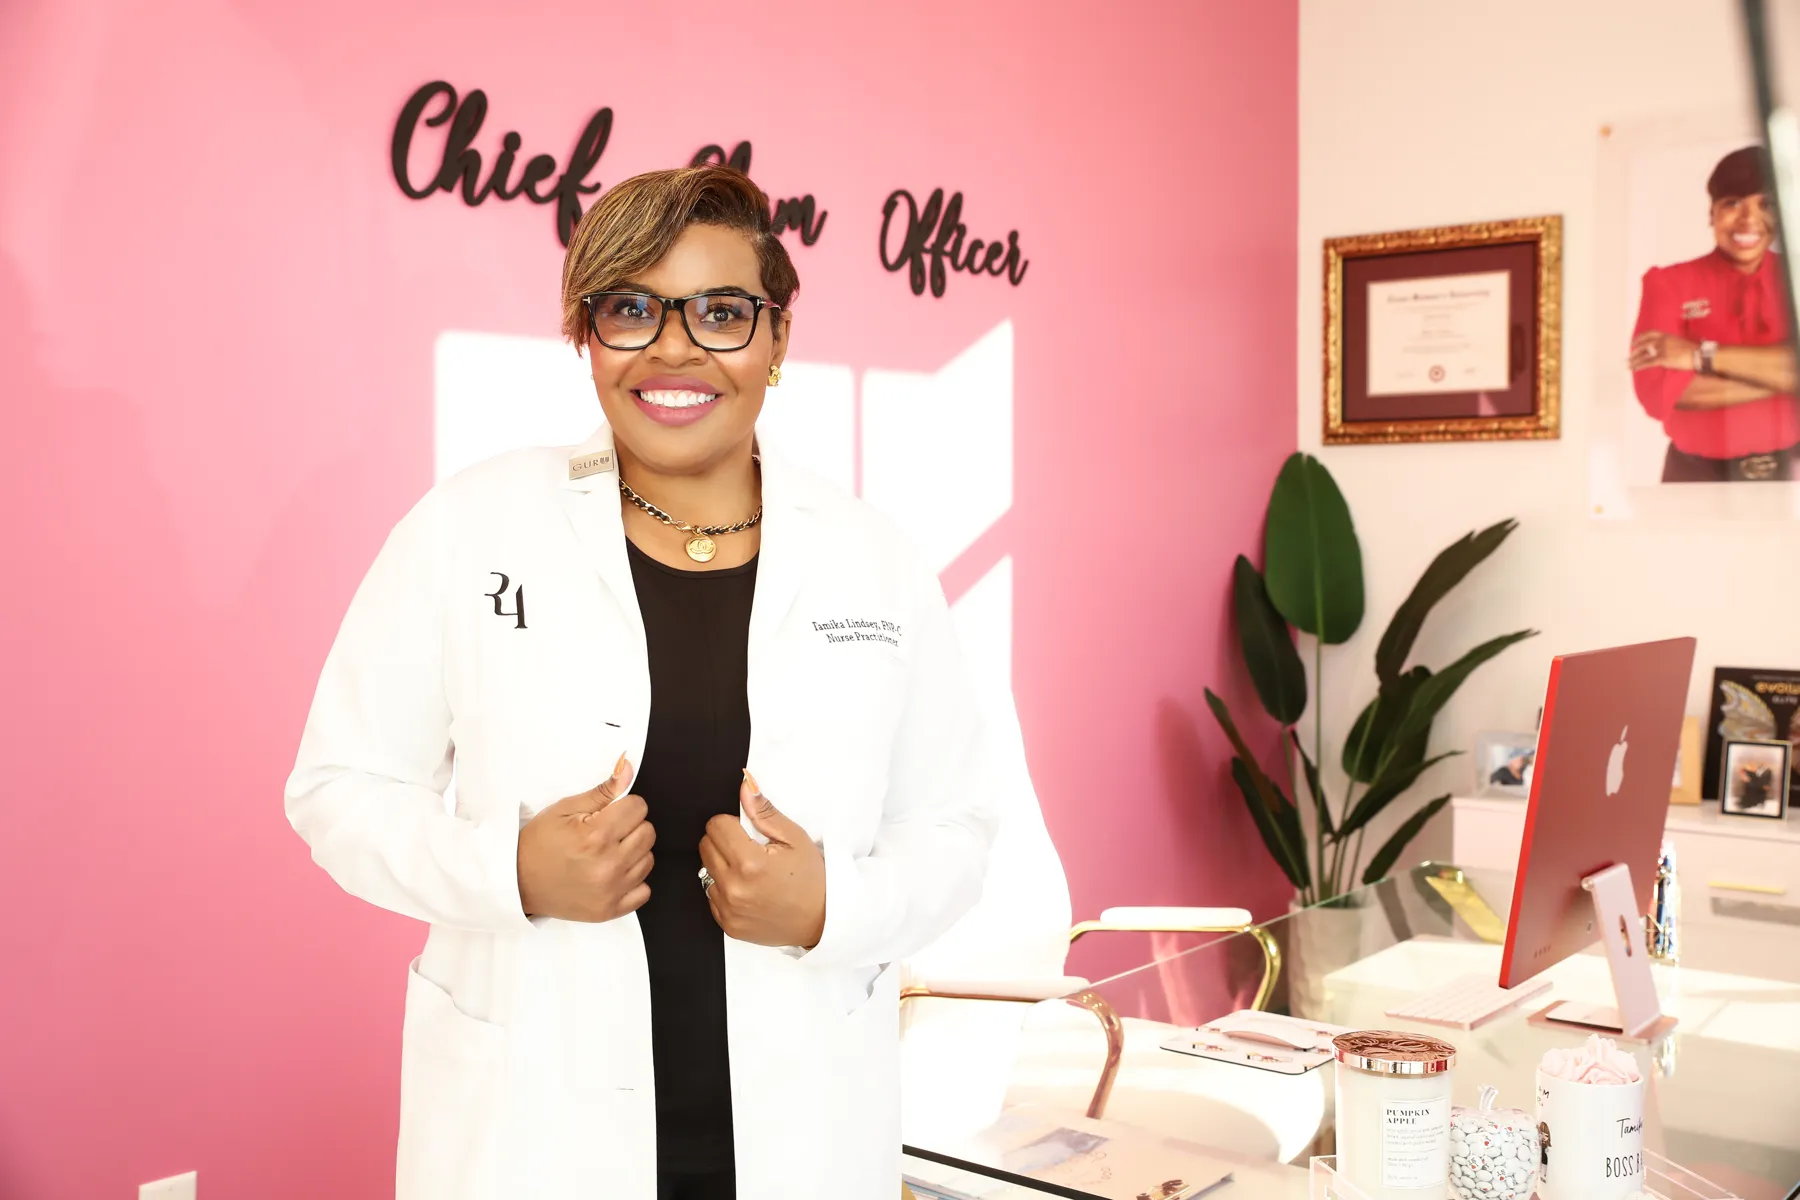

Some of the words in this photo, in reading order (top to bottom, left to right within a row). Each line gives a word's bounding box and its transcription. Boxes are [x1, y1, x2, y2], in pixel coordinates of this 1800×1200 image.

[391, 80, 613, 249] Chief
[879, 187, 1029, 298] Officer
[811, 619, 845, 632] Tamika
[845, 618, 881, 631] Lindsey,
[826, 633, 854, 644] Nurse
[1386, 1108, 1430, 1117] PUMPKIN
[1387, 1117, 1416, 1125] APPLE
[1606, 1154, 1634, 1178] BOSS
